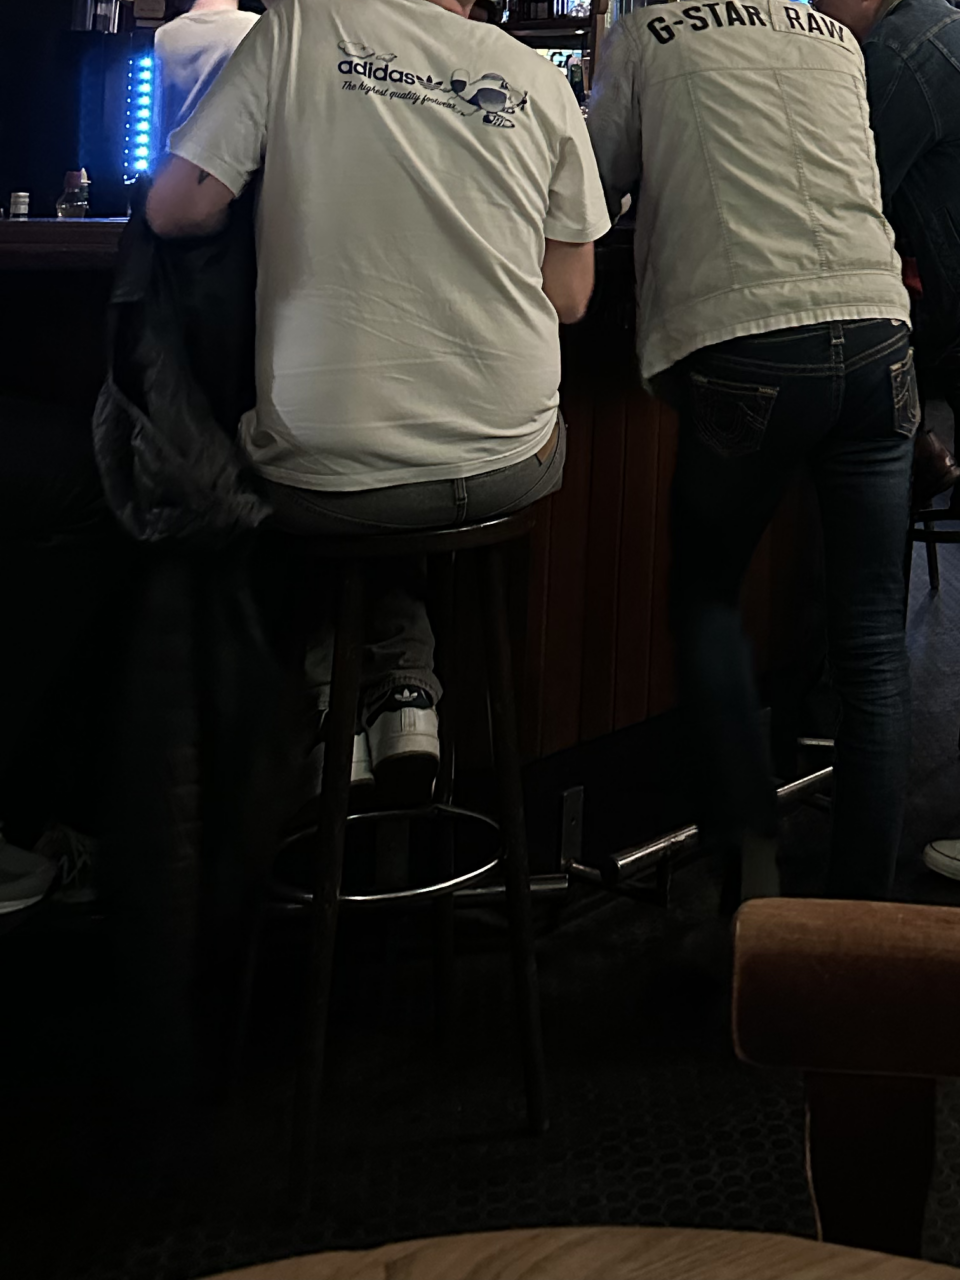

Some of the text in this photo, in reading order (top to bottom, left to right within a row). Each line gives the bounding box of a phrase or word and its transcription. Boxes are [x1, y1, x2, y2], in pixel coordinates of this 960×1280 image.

[647, 1, 847, 46] G-STAR RAW
[337, 57, 417, 88] adidas
[341, 80, 357, 93] The
[357, 81, 389, 102] highest
[388, 88, 422, 109] quality
